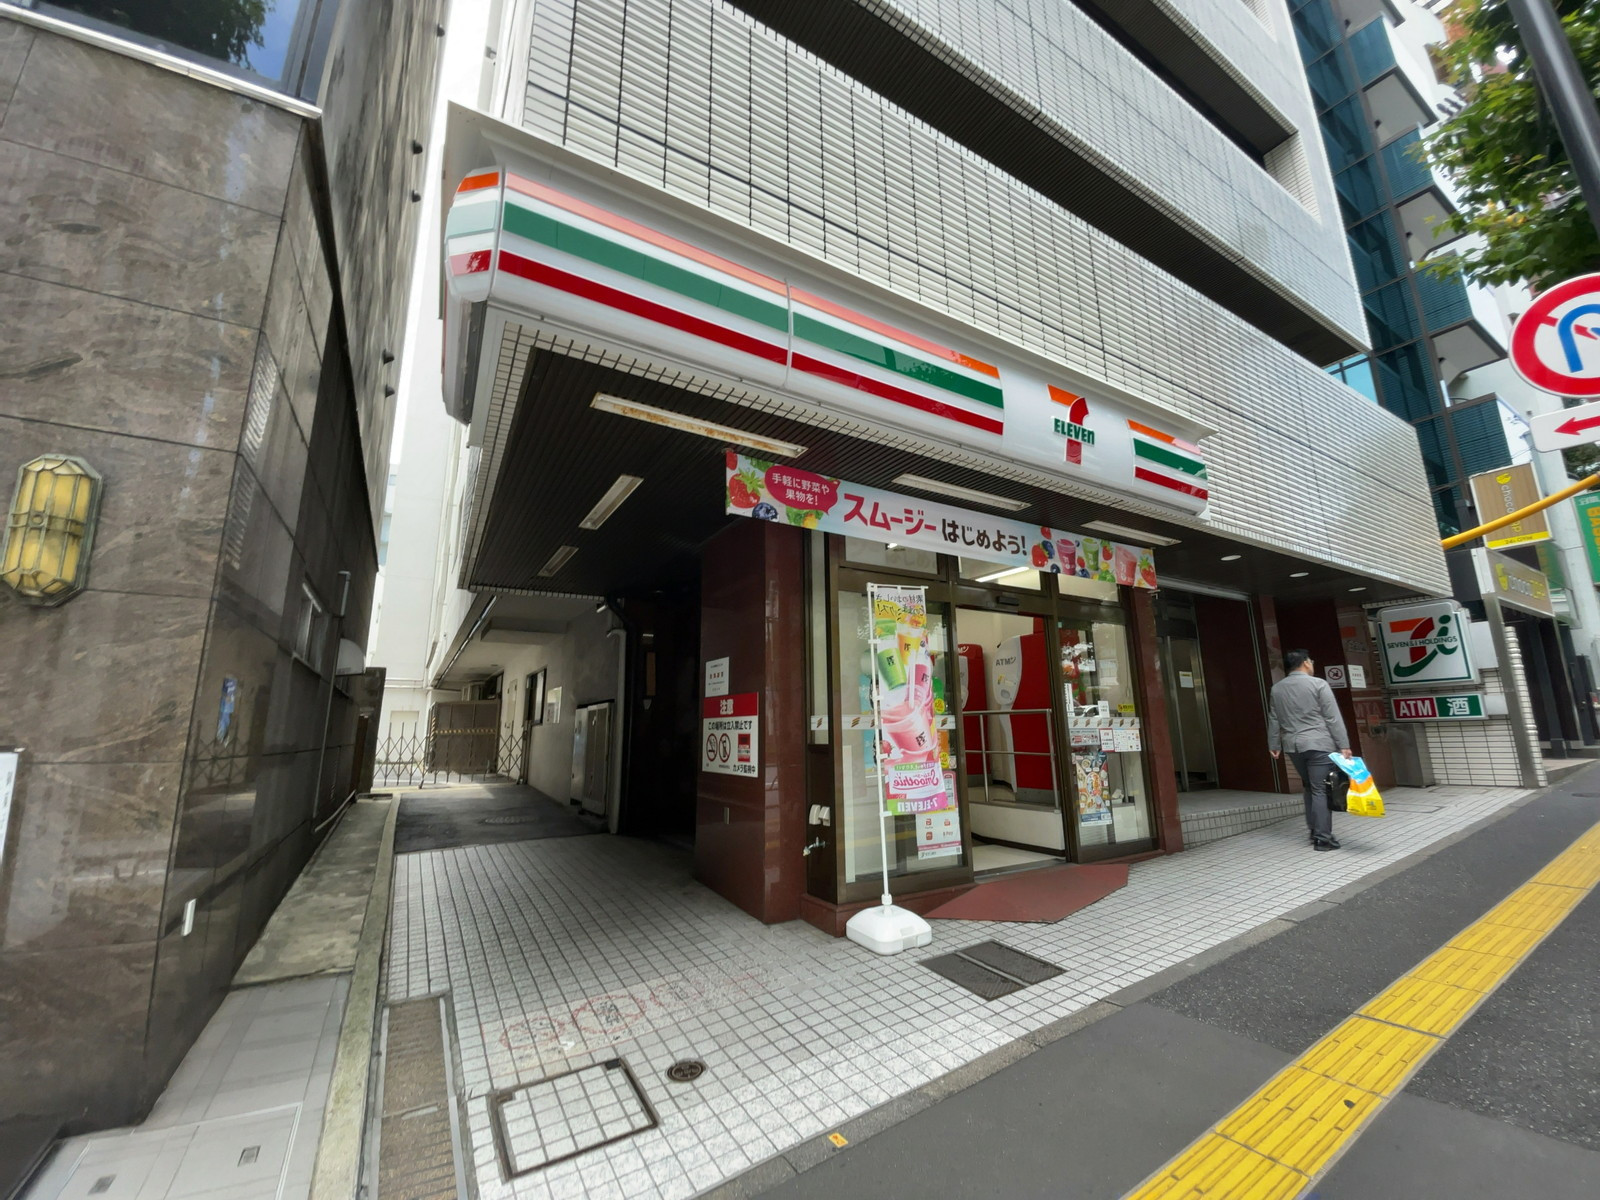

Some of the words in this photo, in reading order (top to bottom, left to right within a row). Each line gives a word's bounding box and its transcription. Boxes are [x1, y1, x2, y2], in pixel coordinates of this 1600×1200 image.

[771, 472, 830, 495] 手軽に野菜や
[785, 490, 819, 506] 果物を!
[1419, 636, 1458, 646] HOLDINGS
[996, 658, 1011, 666] ATM
[1399, 700, 1432, 717] ATM
[1446, 697, 1470, 716] 酒
